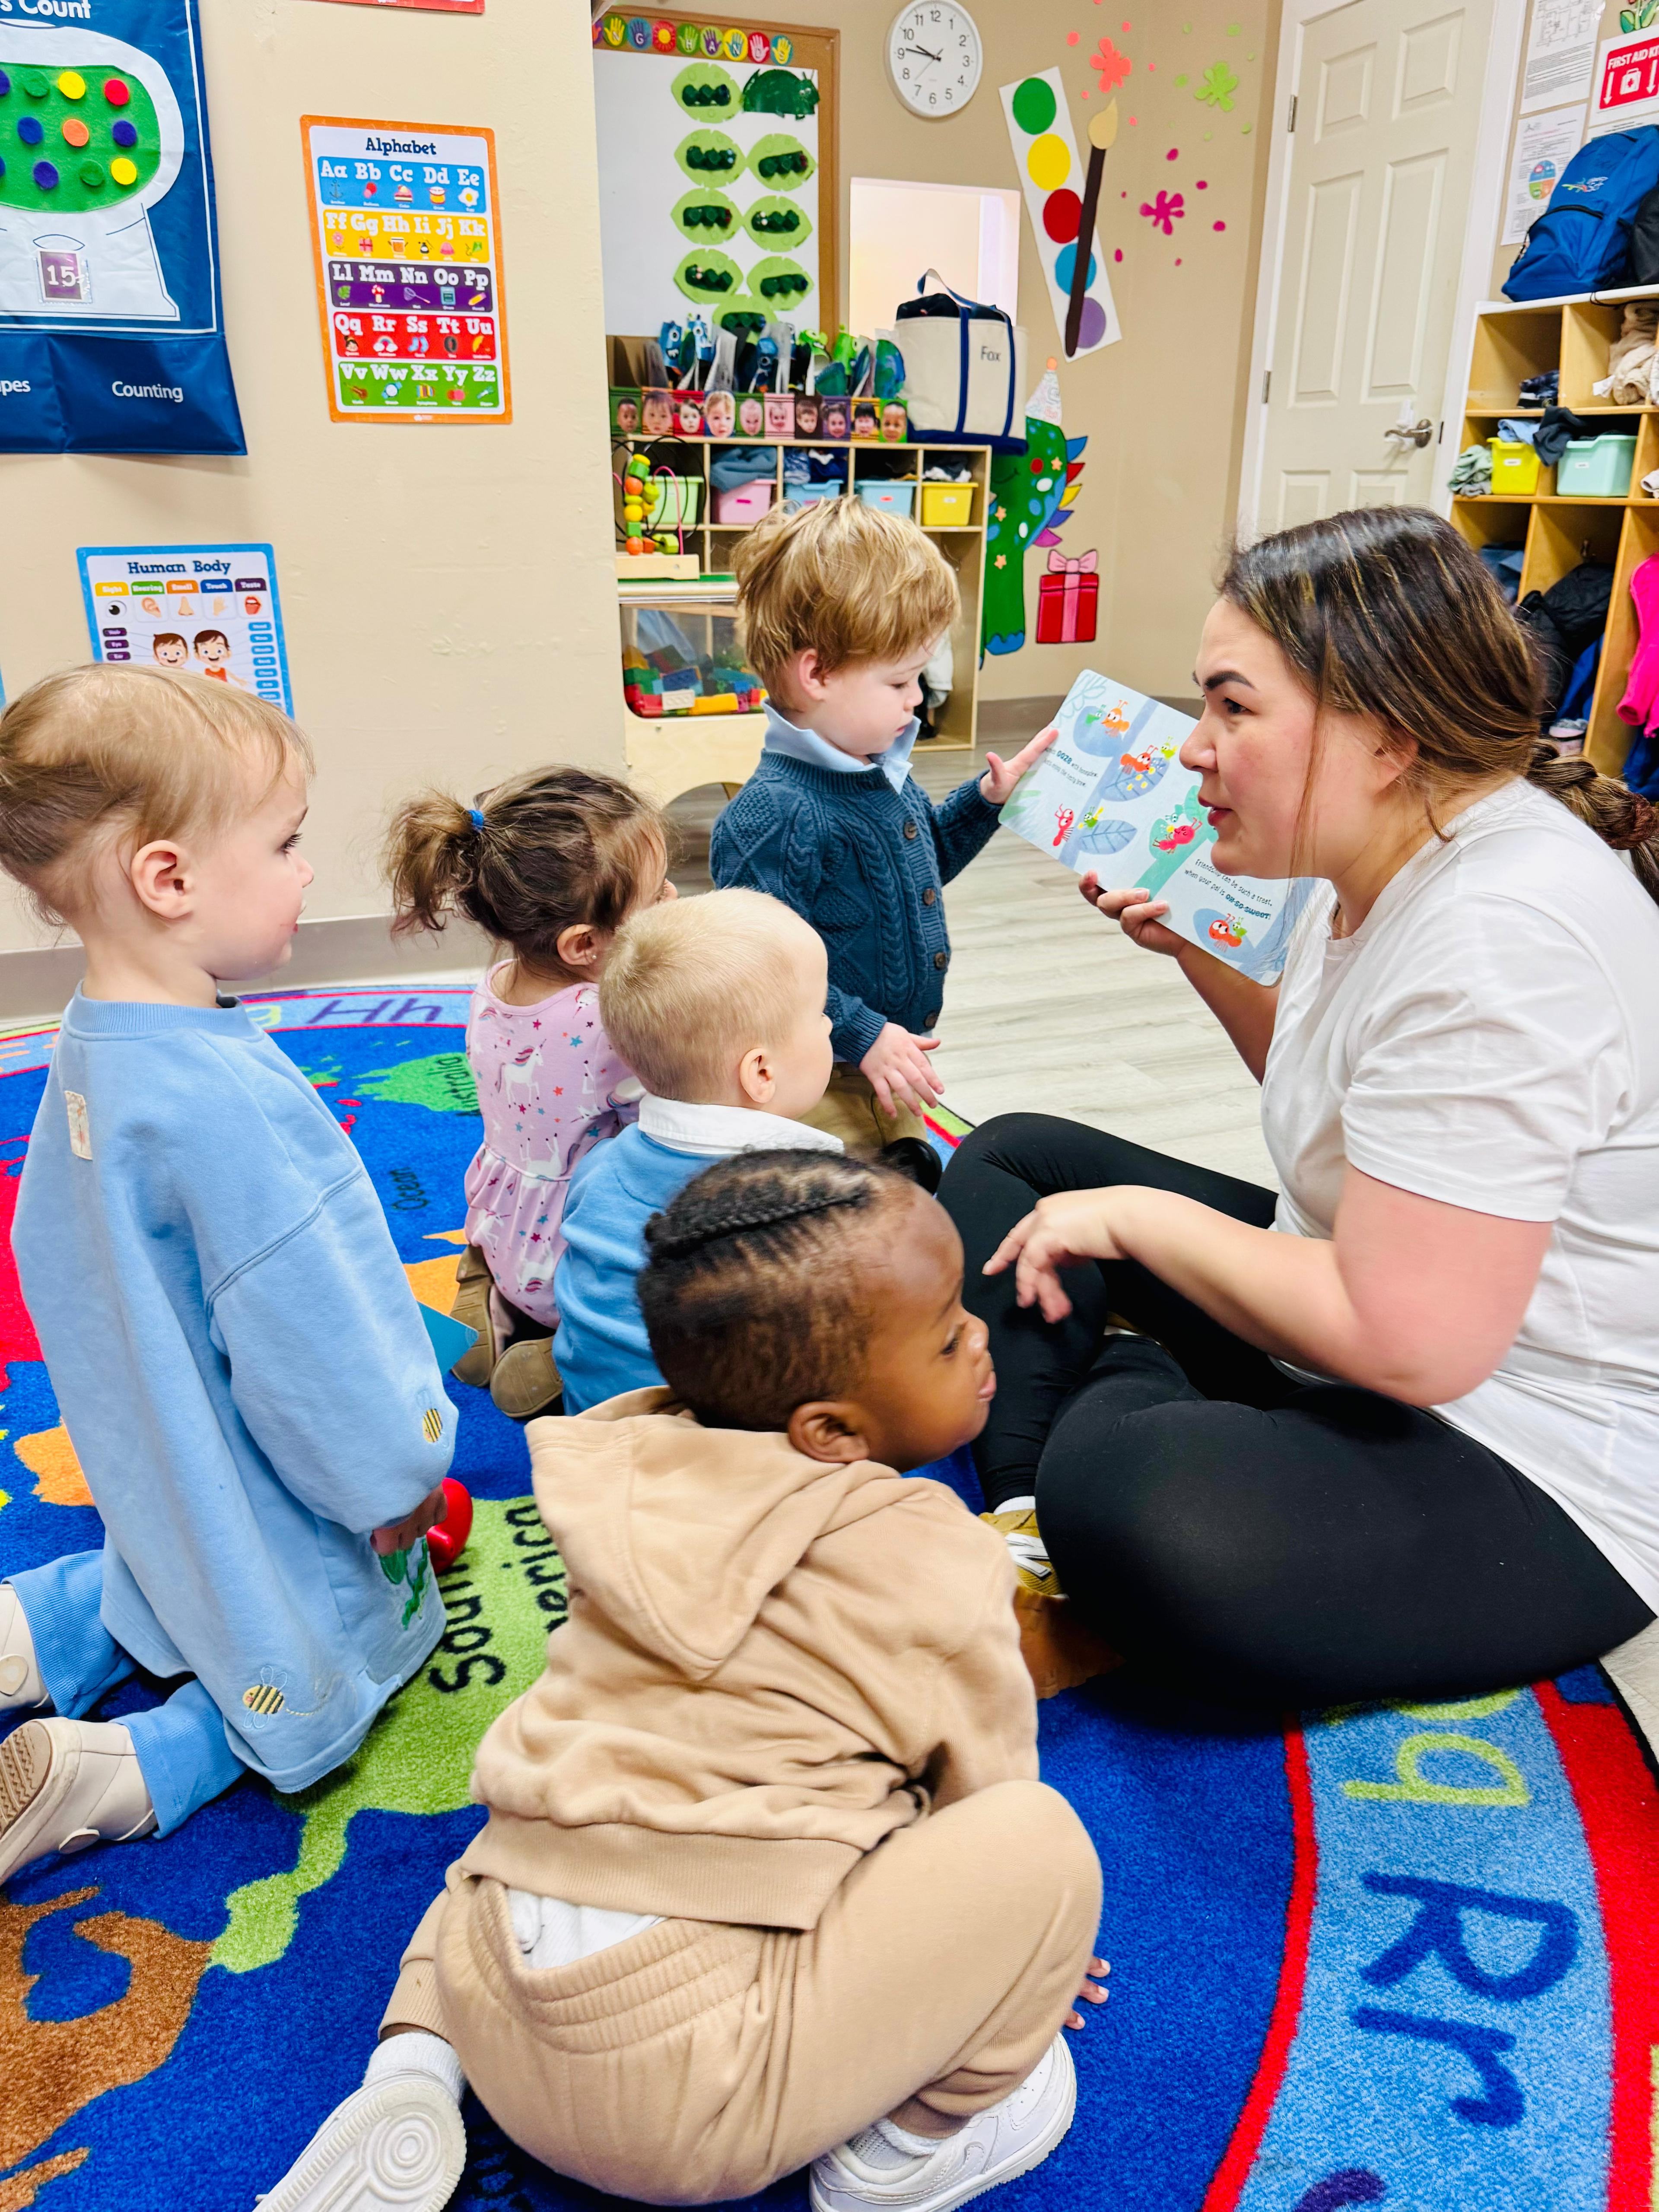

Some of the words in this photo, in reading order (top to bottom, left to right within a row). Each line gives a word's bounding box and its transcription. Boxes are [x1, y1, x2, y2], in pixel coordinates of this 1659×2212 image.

[915, 14, 923, 25] 11
[930, 10, 941, 22] 12
[949, 18, 953, 29] 1
[903, 29, 914, 41] 10
[959, 35, 967, 47] 2
[897, 48, 905, 60] 9
[963, 55, 970, 67] 3
[1607, 53, 1633, 70] FIRST
[1631, 48, 1649, 64] AID
[903, 68, 910, 79] 8
[957, 75, 964, 86] 4
[914, 84, 922, 96] 7
[929, 92, 937, 104] 6
[945, 88, 953, 100] 5
[365, 137, 437, 156] Alphabet
[321, 160, 348, 178] Aa
[354, 162, 381, 180] Bb
[390, 165, 413, 182] Cc
[423, 166, 450, 184] Dd
[457, 168, 480, 186] Ee
[325, 212, 347, 230] Ff
[350, 213, 378, 236] Gg
[382, 215, 410, 233] Hh
[414, 216, 431, 235] Ii
[435, 218, 454, 240] Jj
[458, 219, 486, 237] Kk
[47, 265, 76, 287] 15
[332, 264, 353, 281] Ll
[359, 264, 395, 283] Mm
[400, 267, 428, 284] Nn
[433, 268, 459, 286] Oo
[464, 269, 489, 291] Pp
[334, 314, 363, 336] Qq
[371, 315, 397, 332] Rr
[406, 316, 428, 334] Ss
[436, 317, 461, 334] Tt
[465, 318, 493, 335] Uu
[981, 346, 1001, 362] Fox
[340, 363, 368, 380] Vv
[370, 364, 408, 381] Ww
[410, 365, 439, 381] Xx
[442, 365, 468, 387] Yy
[472, 366, 496, 382] Zz
[112, 381, 184, 403] Counting
[127, 562, 186, 574] Human
[193, 560, 231, 575] Body
[1184, 869, 1198, 879] when
[1198, 876, 1211, 886] your
[1211, 883, 1221, 892] pal
[1222, 875, 1231, 884] can
[1231, 880, 1238, 888] be
[1238, 886, 1250, 897] such
[306, 998, 443, 1024] Hh
[501, 1503, 568, 1632] erica
[1349, 1870, 1581, 2128] Rr
